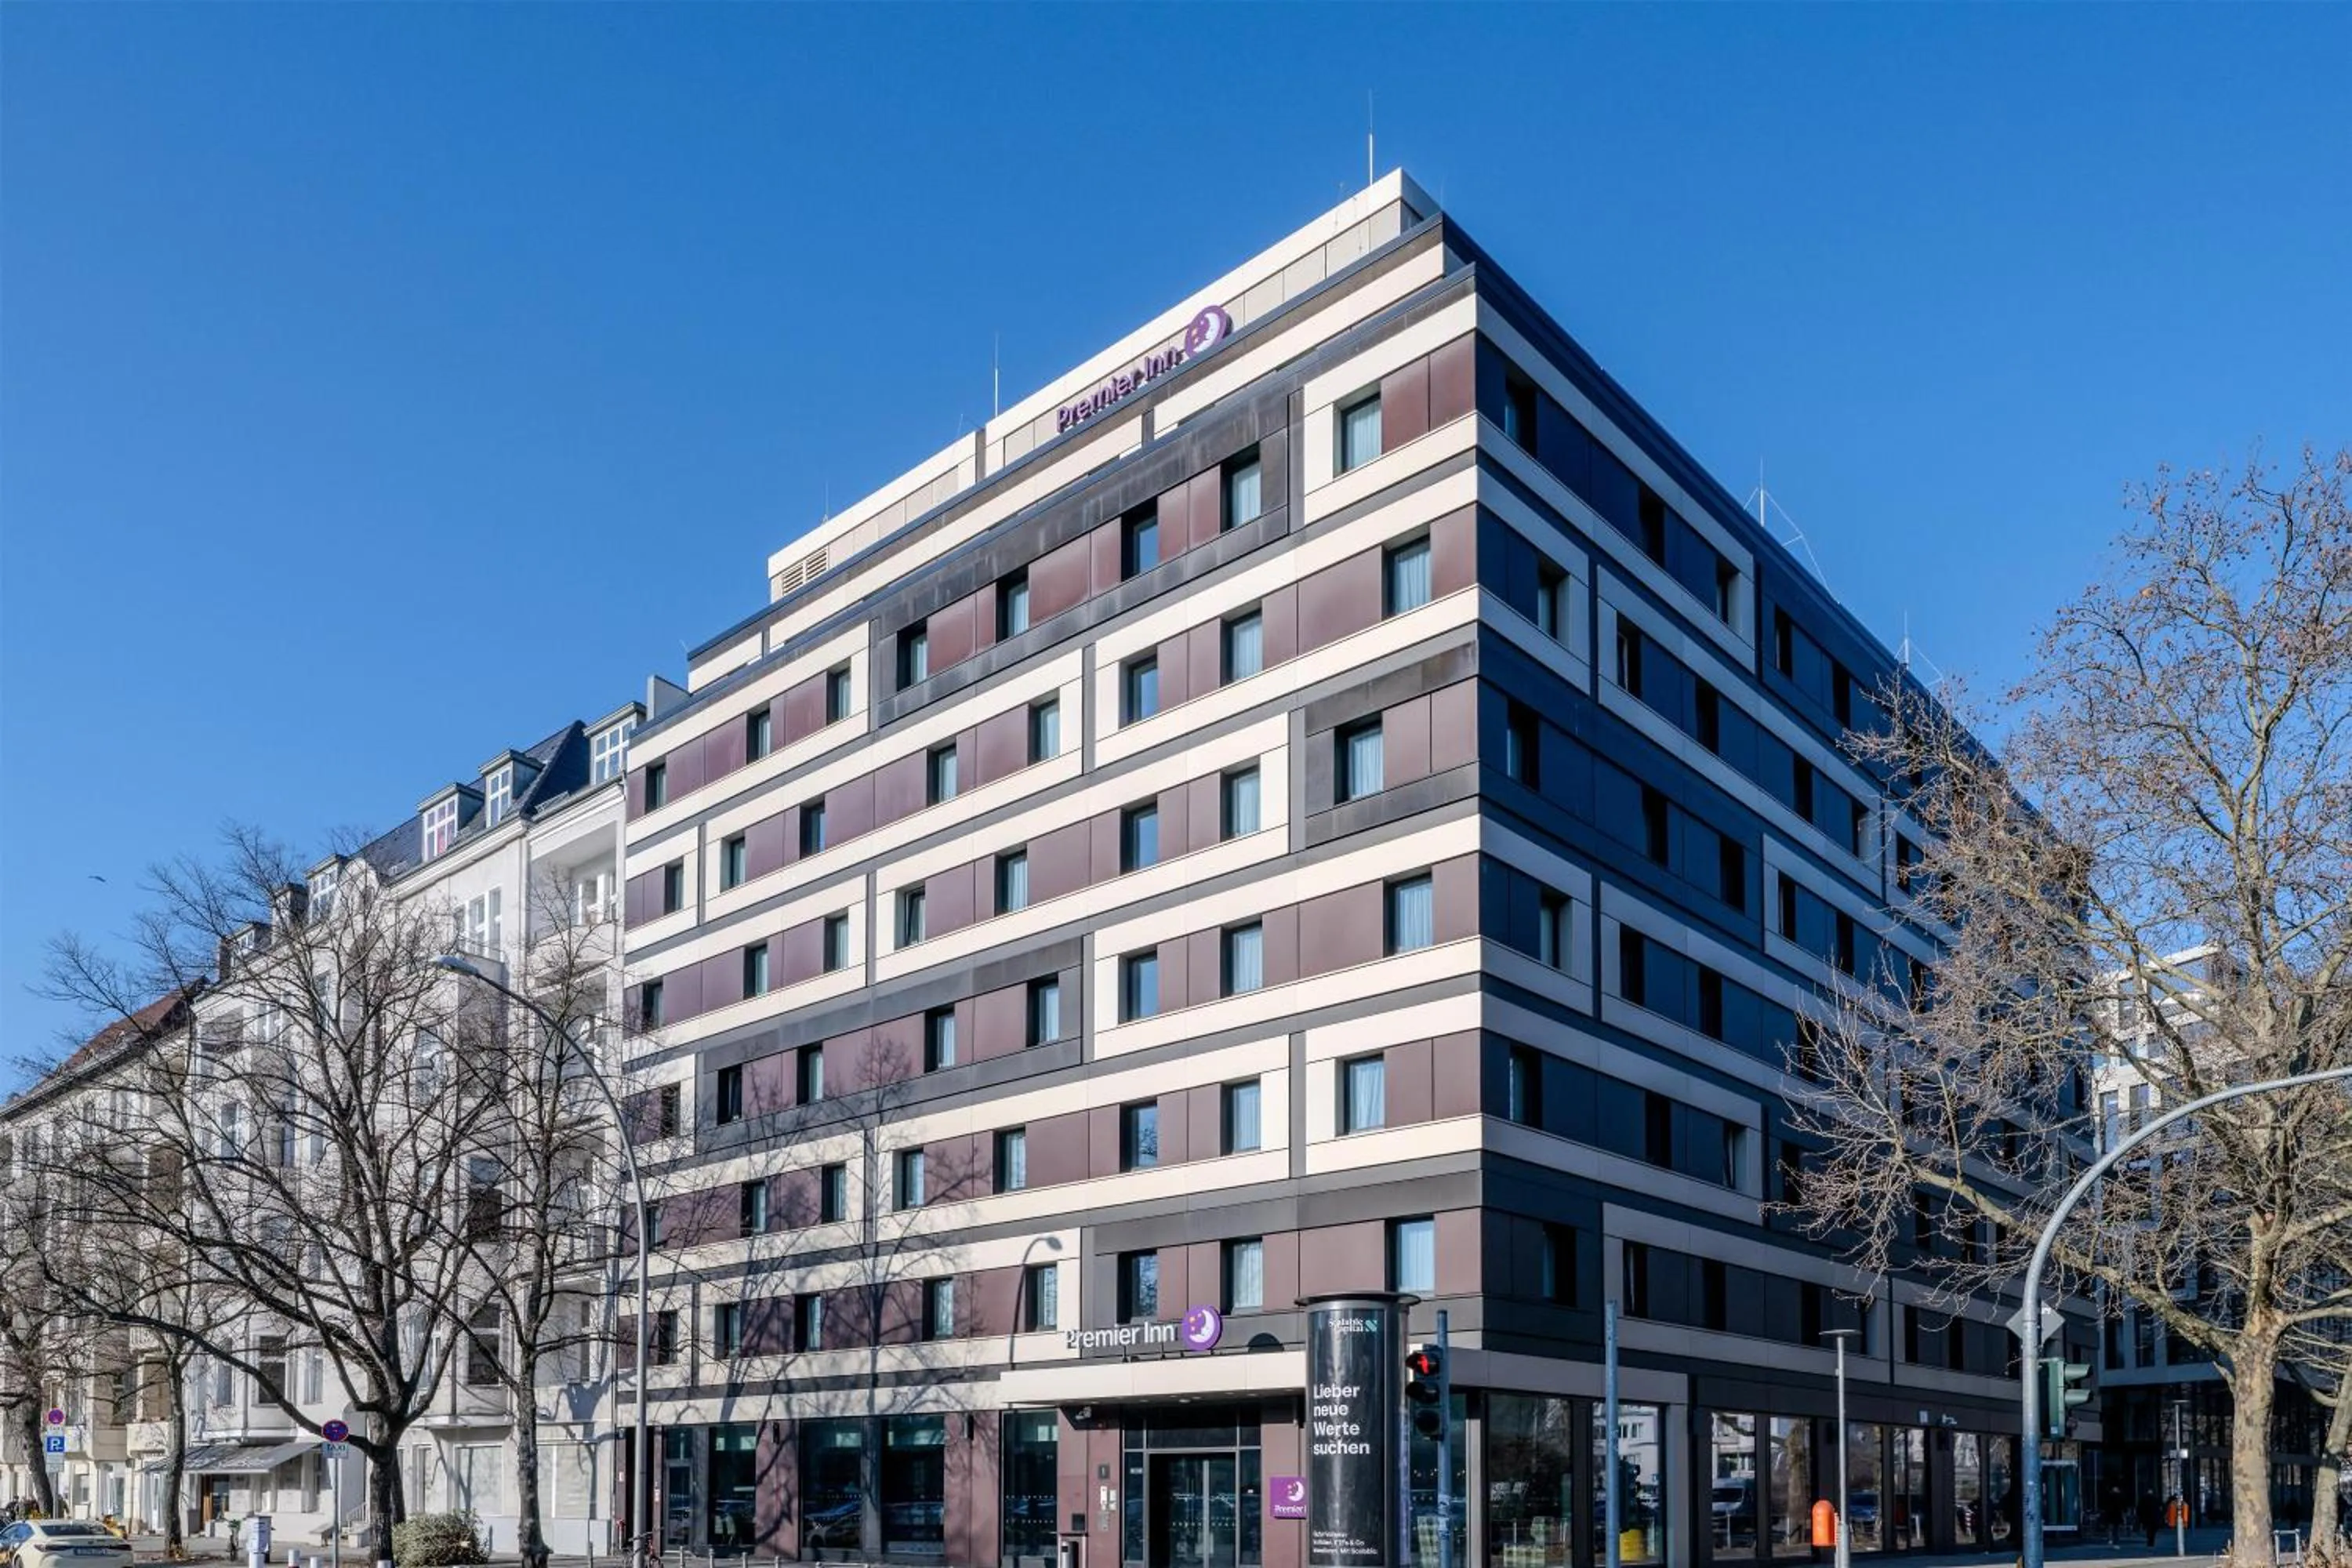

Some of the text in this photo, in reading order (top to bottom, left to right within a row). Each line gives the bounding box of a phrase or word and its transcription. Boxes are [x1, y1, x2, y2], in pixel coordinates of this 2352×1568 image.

[1057, 347, 1181, 432] Premier Inn
[1065, 1322, 1174, 1348] Premier Inn
[1313, 1383, 1360, 1399] Lieber
[1313, 1404, 1348, 1417] neue
[1313, 1421, 1360, 1436] Werte
[1313, 1439, 1370, 1455] suchen
